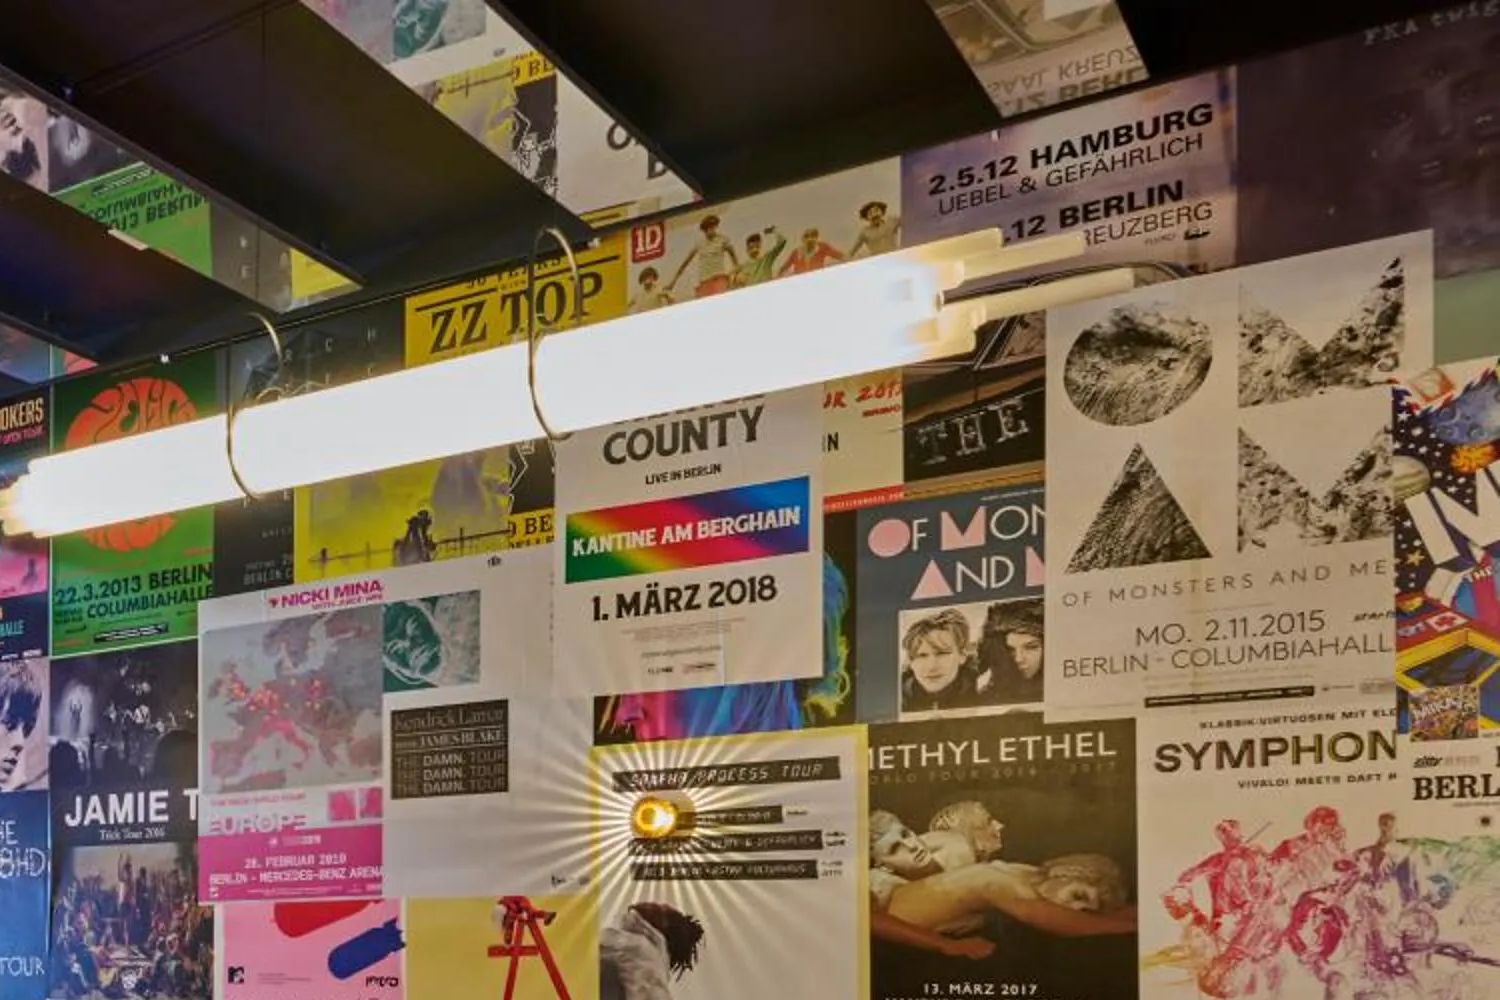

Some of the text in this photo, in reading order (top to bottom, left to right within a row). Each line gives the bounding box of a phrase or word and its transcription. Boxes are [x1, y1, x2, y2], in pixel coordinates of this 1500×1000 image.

[929, 103, 1214, 195] 2.5.12 HAMBURG
[938, 132, 1204, 216] UEBEL & GEFÄHRLICH
[1059, 180, 1185, 228] BERLIN
[430, 271, 604, 354] ZZ TOP
[603, 405, 766, 466] COUNTY
[645, 471, 668, 485] LIVE
[684, 463, 722, 480] BERLIN
[572, 506, 801, 557] KANTINE AM BERGHAIN
[55, 562, 213, 606] 22.3.2013 BERLIN
[282, 586, 330, 608] NICKI
[593, 575, 777, 621] 1. MÄRZ 2018
[911, 554, 1015, 600] AND
[1061, 591, 1093, 607] OF
[1108, 573, 1255, 602] MONSTERS
[1270, 563, 1332, 584] AND
[1136, 609, 1326, 648] MO. 2.11.2015
[1063, 653, 1149, 679] BERLIN
[1001, 732, 1117, 762] ETHEL
[1154, 730, 1397, 773] SYMPHON
[781, 763, 823, 778] TOUR
[64, 790, 169, 828] JAMIE
[209, 815, 306, 836] EUROPE
[0, 956, 46, 976] TOUR
[923, 980, 1038, 996] 13. MÄRZ 2017
